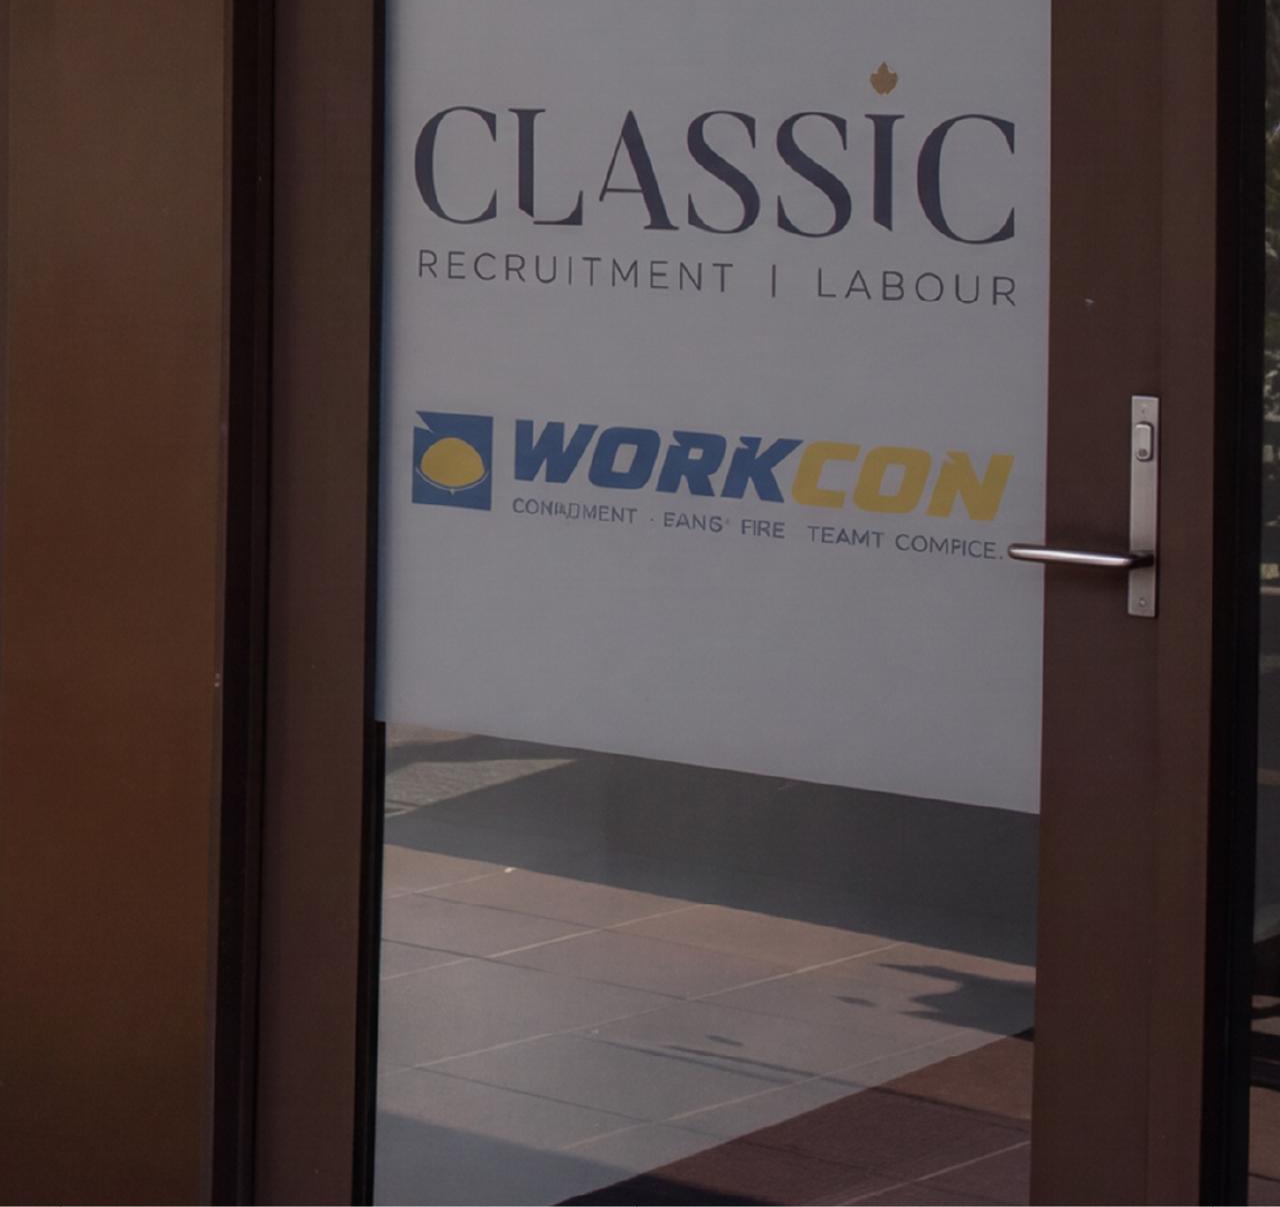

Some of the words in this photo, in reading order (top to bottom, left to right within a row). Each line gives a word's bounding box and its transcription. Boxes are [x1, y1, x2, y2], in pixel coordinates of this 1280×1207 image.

[414, 105, 1016, 245] CLASSIC
[418, 249, 734, 293] RECRUITMENT
[817, 268, 1016, 307] LABOUR
[513, 418, 1015, 522] WORKCON
[741, 519, 786, 540] FIRE
